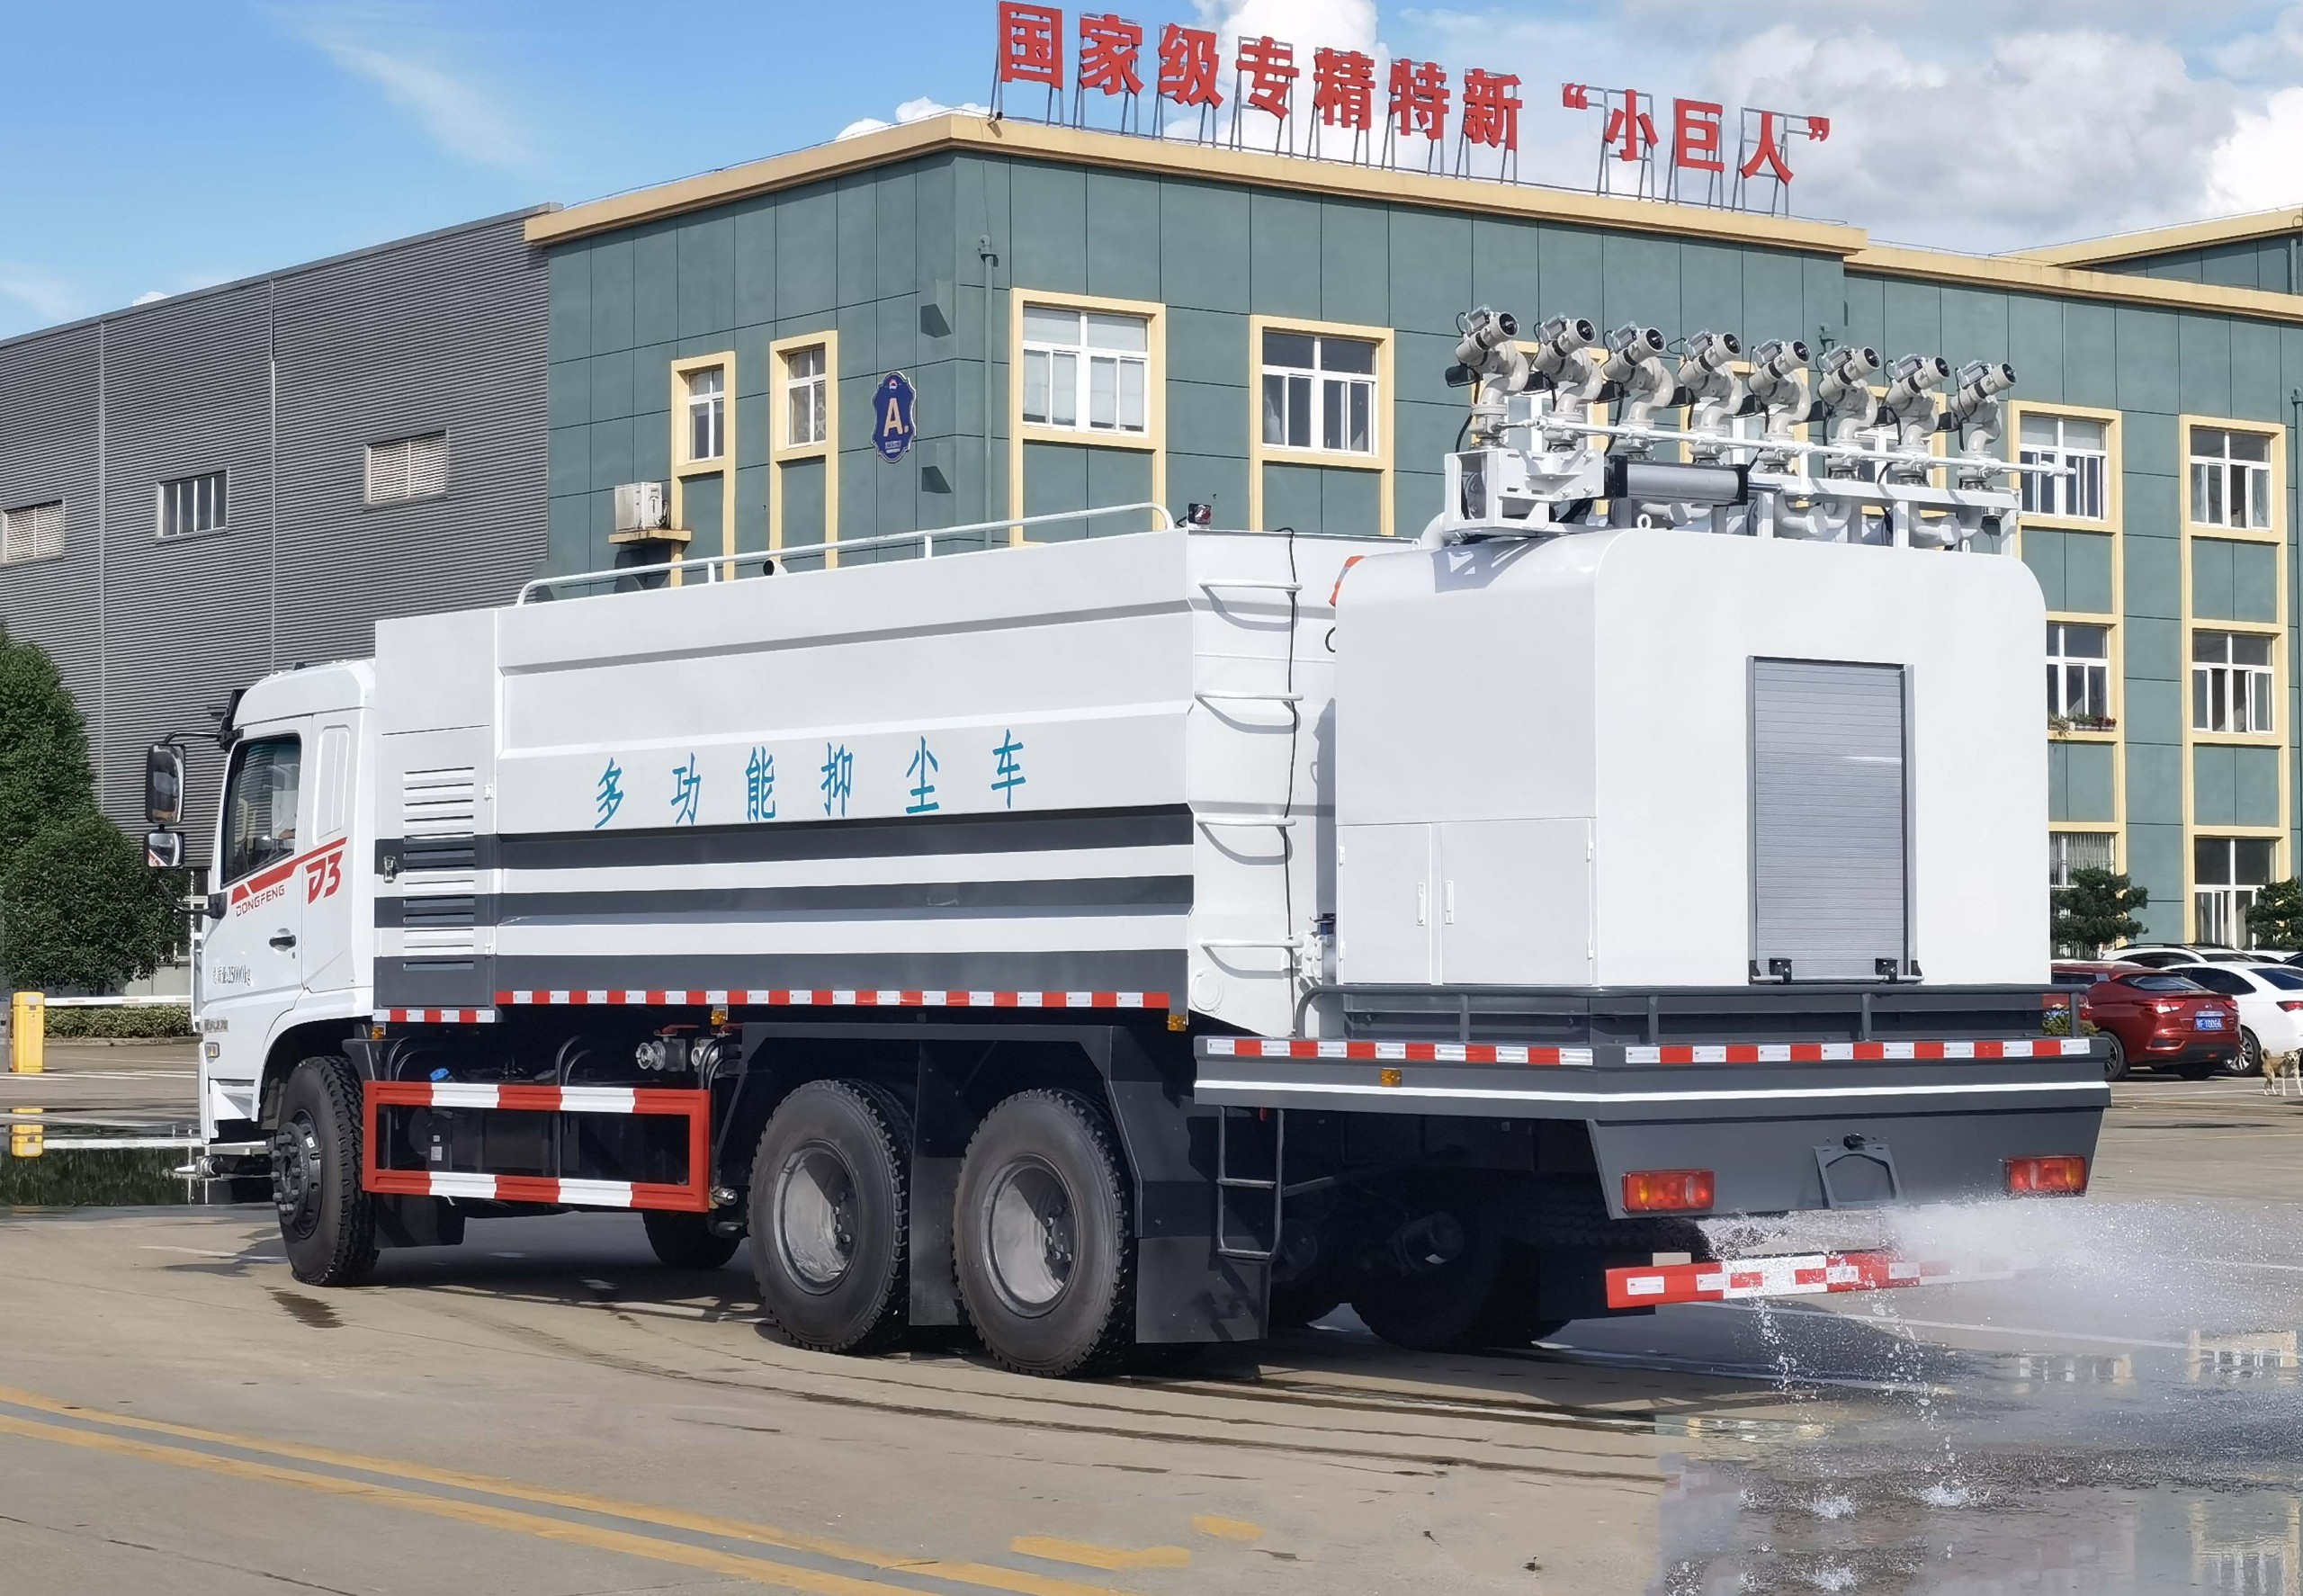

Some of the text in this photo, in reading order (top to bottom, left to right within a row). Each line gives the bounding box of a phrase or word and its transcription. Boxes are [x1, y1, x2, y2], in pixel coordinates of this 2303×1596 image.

[595, 729, 1026, 829] 多功能抑尘车
[236, 884, 285, 917] DONGFENG
[306, 850, 343, 904] D3
